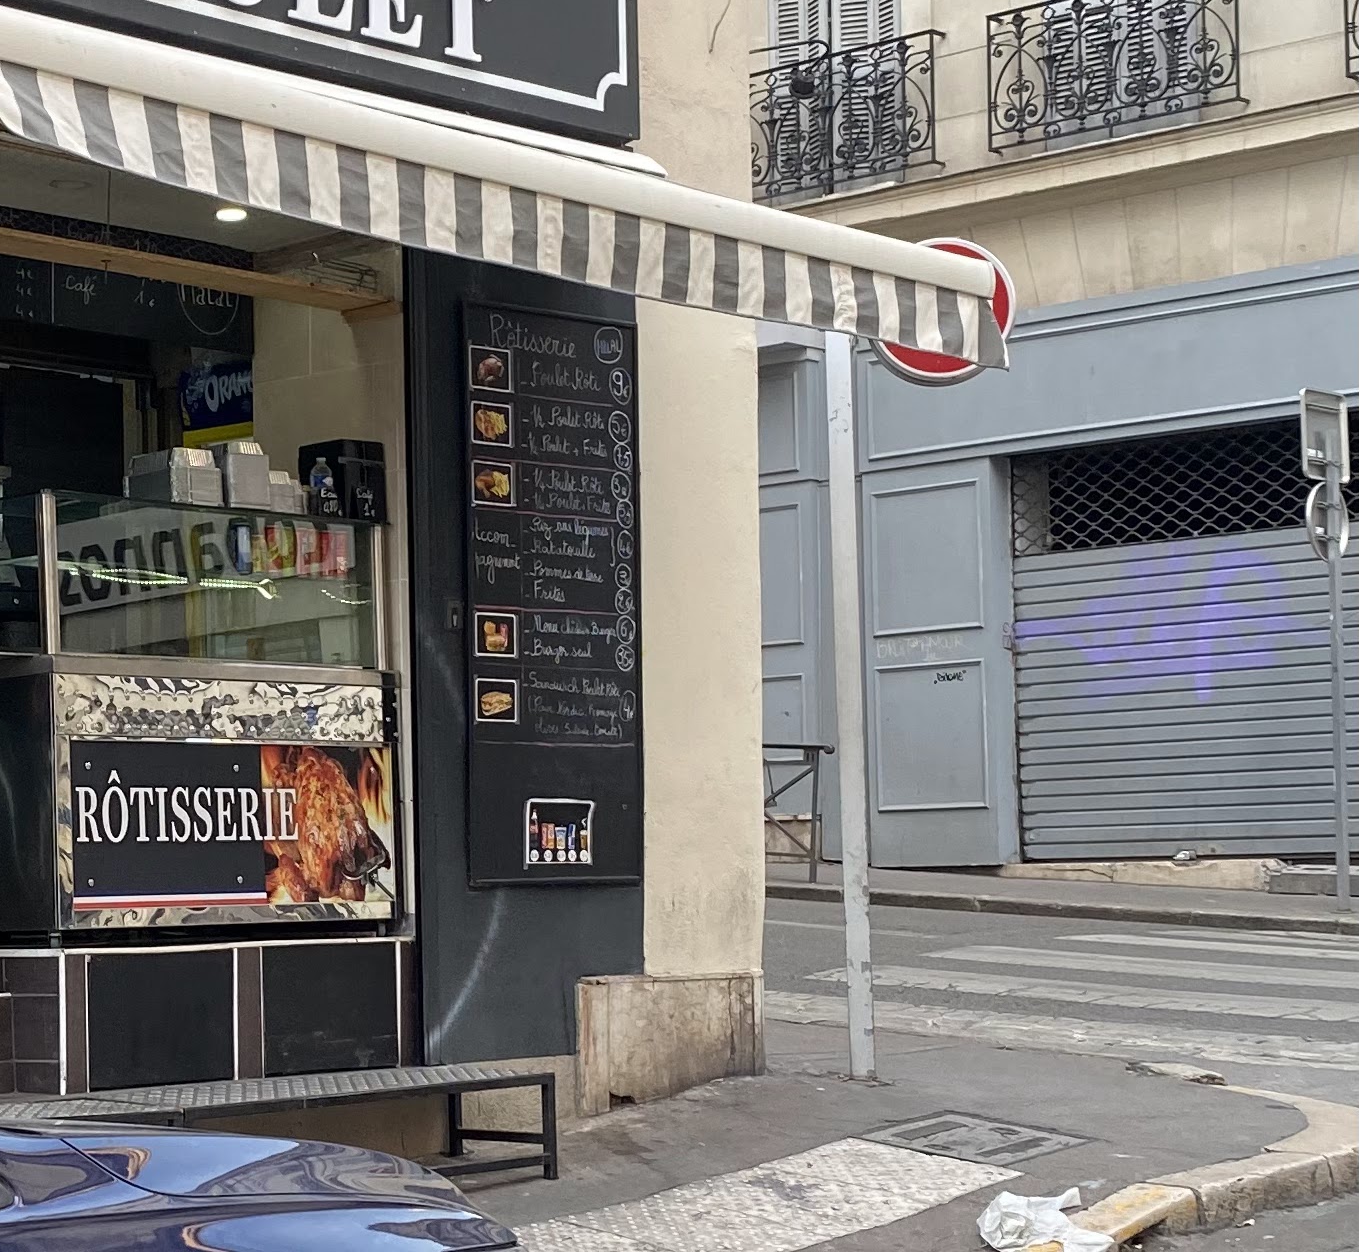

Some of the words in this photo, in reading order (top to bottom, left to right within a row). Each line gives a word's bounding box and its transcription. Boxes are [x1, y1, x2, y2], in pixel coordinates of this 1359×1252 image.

[64, 274, 97, 305] Café
[490, 313, 577, 359] Rôtisserie
[530, 360, 570, 388] Poulet
[548, 406, 582, 428] Poulet
[74, 769, 298, 844] RÔTISSERIE
